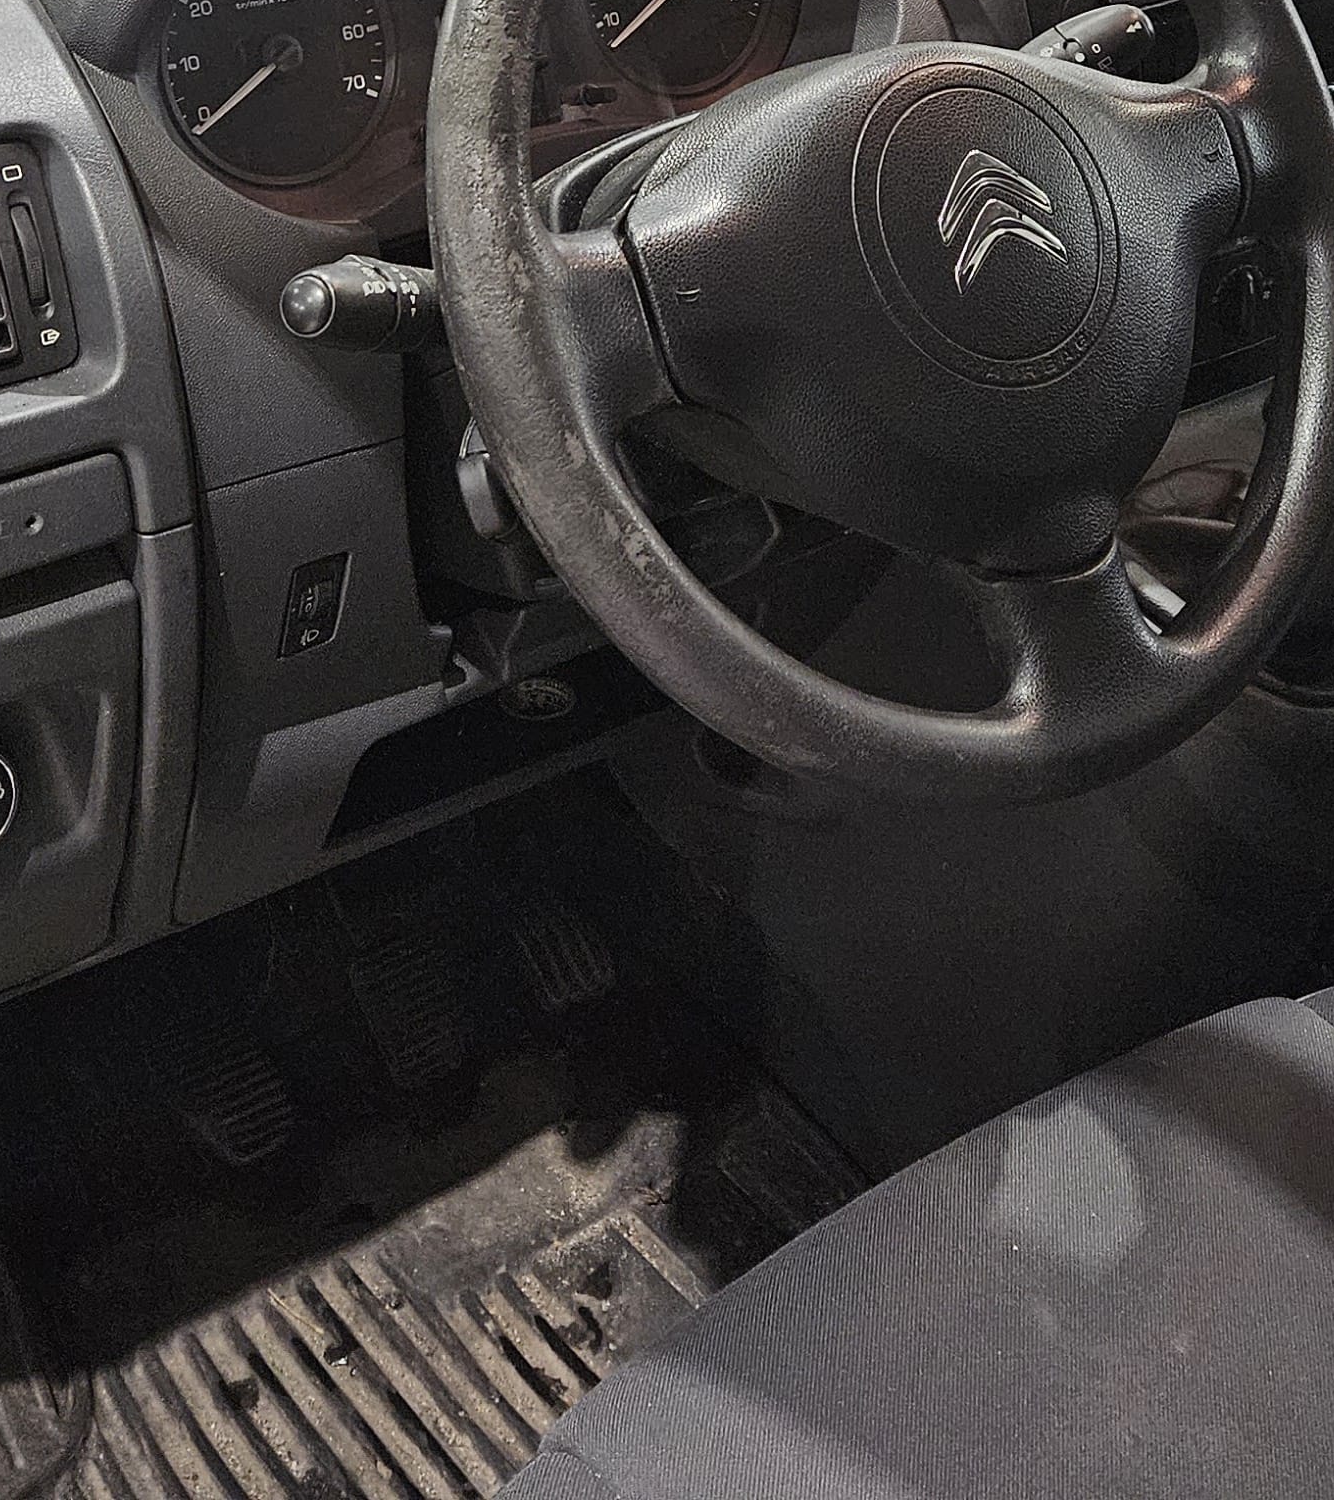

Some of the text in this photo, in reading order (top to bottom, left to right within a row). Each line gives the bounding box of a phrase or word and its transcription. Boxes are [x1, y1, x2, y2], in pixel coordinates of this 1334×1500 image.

[189, 0, 213, 18] 20
[603, 12, 620, 27] 10
[342, 23, 365, 41] 60
[179, 55, 200, 72] 10
[342, 74, 366, 92] 70
[197, 106, 211, 122] 0
